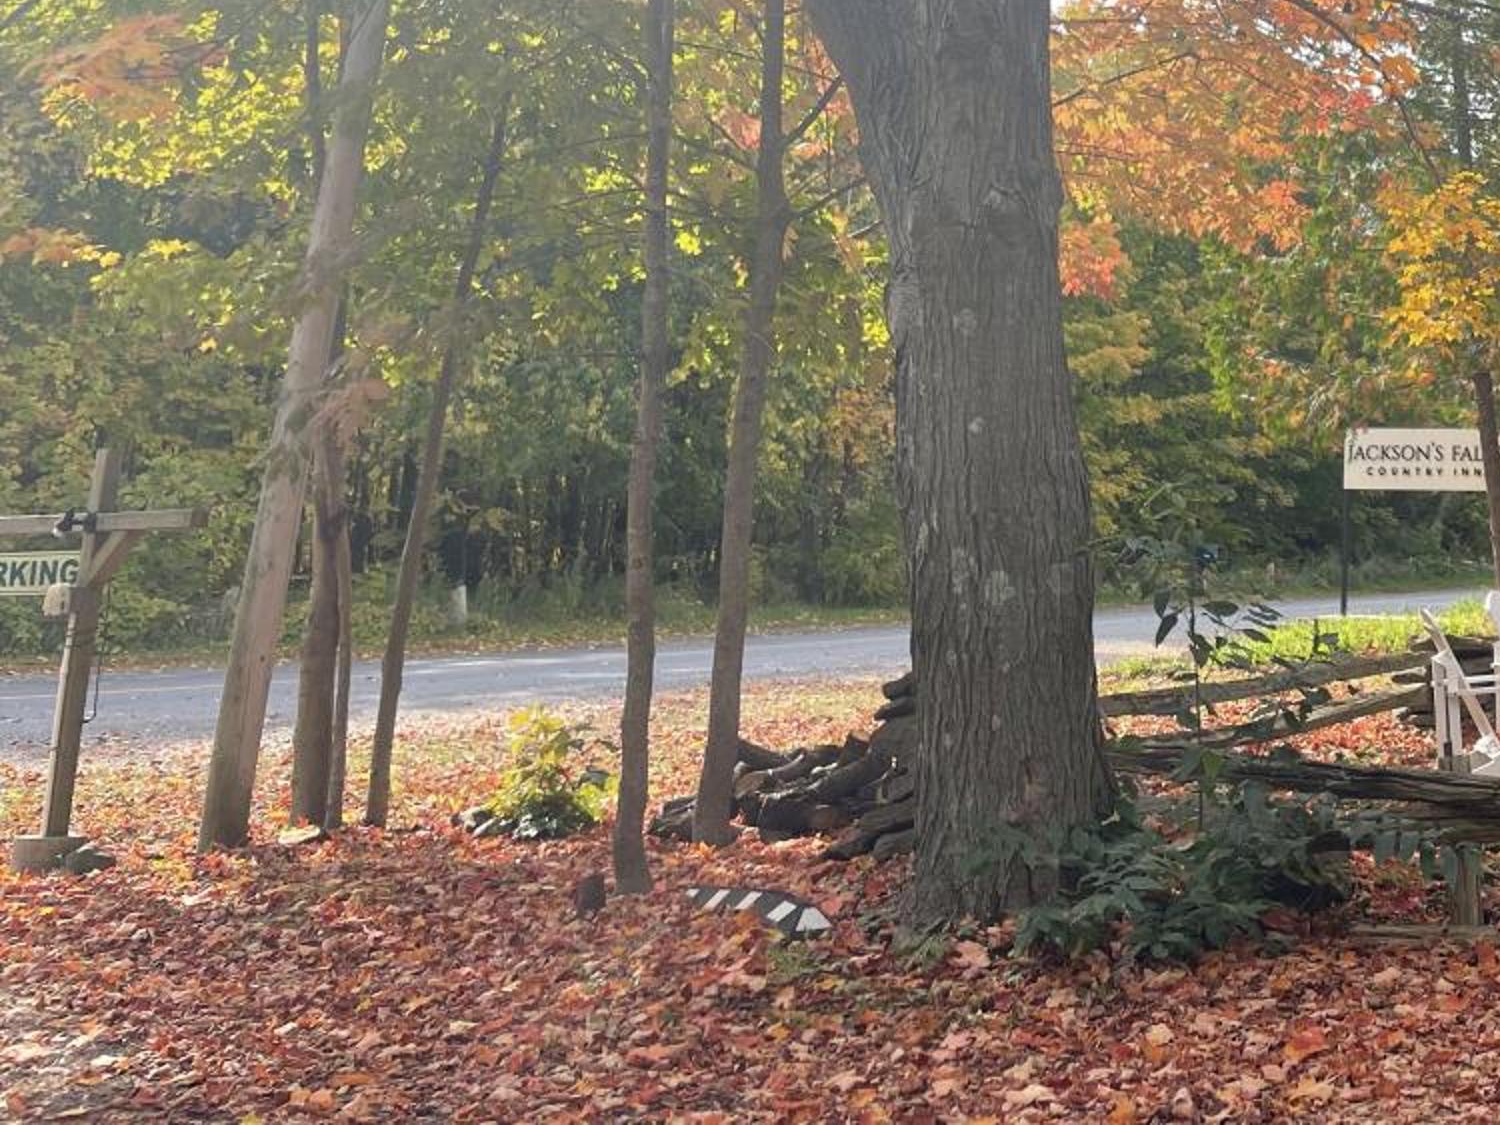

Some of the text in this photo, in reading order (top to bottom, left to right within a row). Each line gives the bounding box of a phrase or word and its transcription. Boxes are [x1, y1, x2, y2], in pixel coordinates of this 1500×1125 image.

[1348, 443, 1443, 462] JACKSON'S
[1366, 466, 1482, 476] COUNTRY INN
